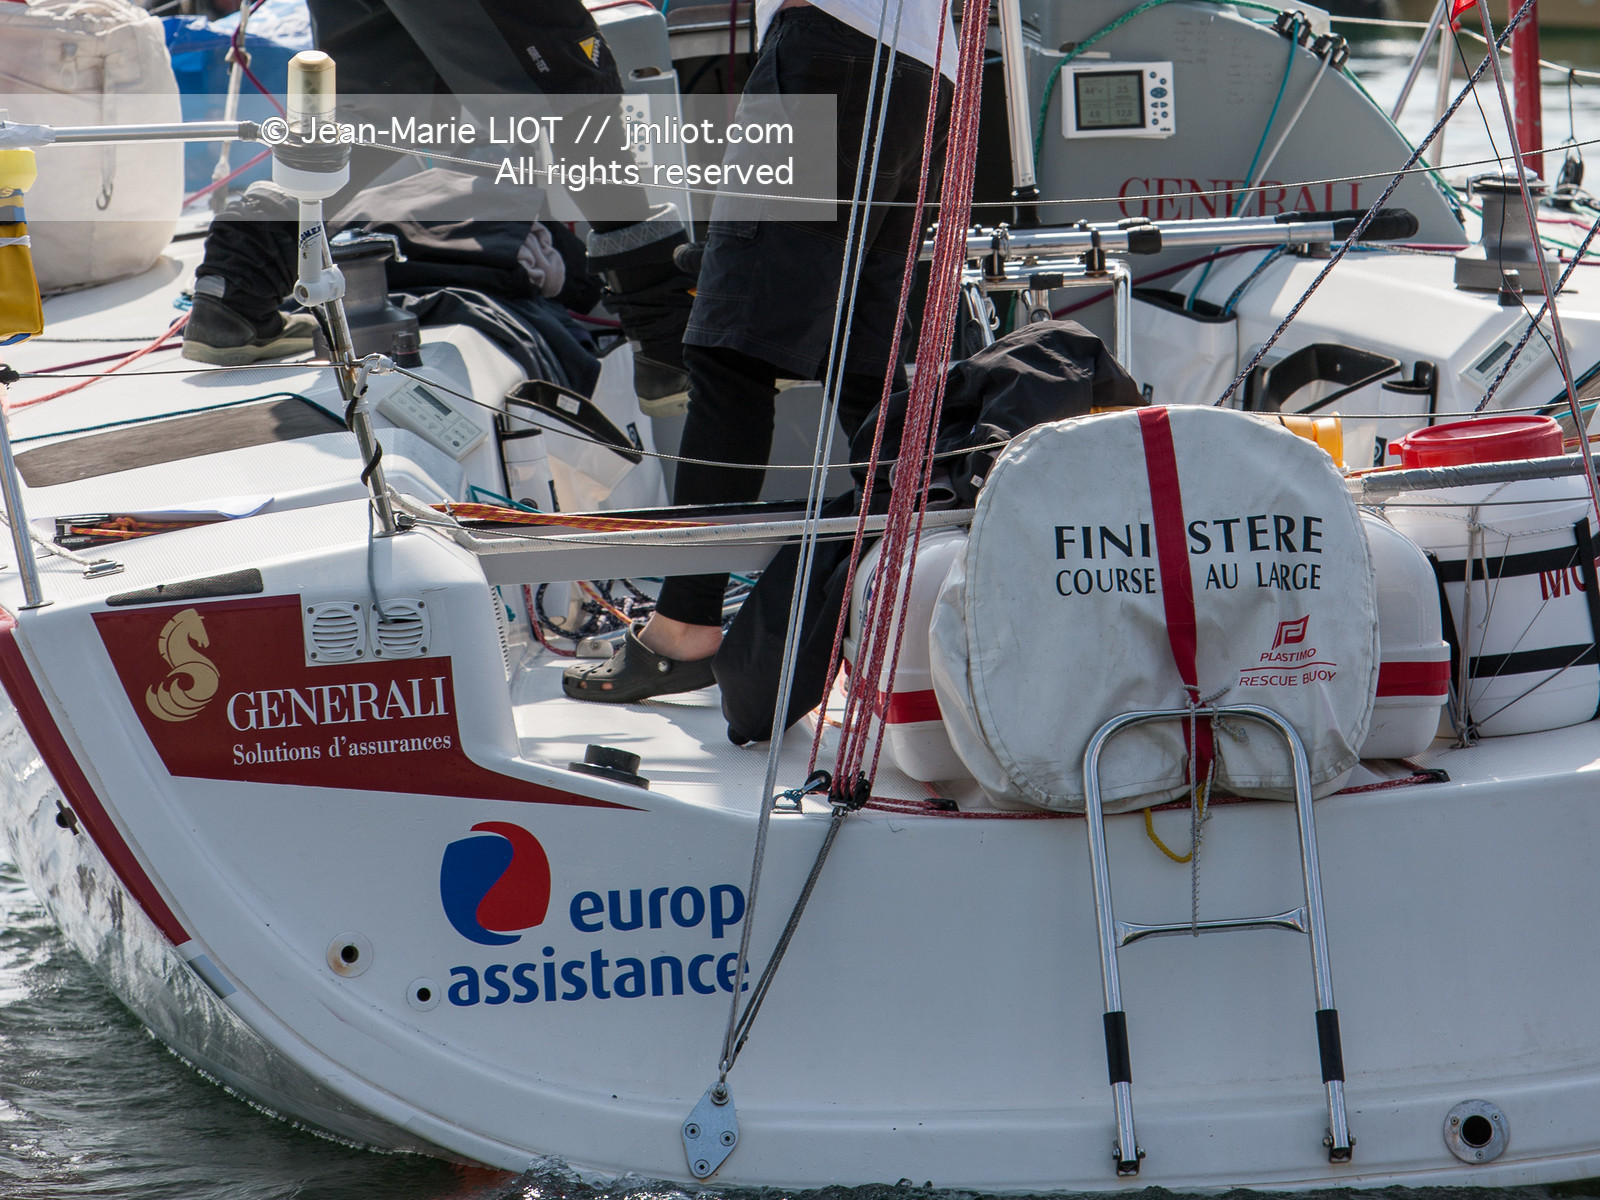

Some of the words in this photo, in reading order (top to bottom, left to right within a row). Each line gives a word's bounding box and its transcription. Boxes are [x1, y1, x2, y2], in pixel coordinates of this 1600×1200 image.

[1055, 567, 1157, 597] COURSE
[1205, 562, 1239, 591] AU
[1255, 561, 1322, 592] LARGE
[1260, 647, 1317, 662] PLASTIMO
[1239, 675, 1298, 687] RESCUE
[1302, 669, 1337, 685] BUOY
[226, 676, 450, 732] GENERALI
[232, 741, 322, 766] Solutions
[328, 735, 452, 758] d'assurances
[569, 883, 747, 939] europ
[447, 945, 751, 1007] assistance
